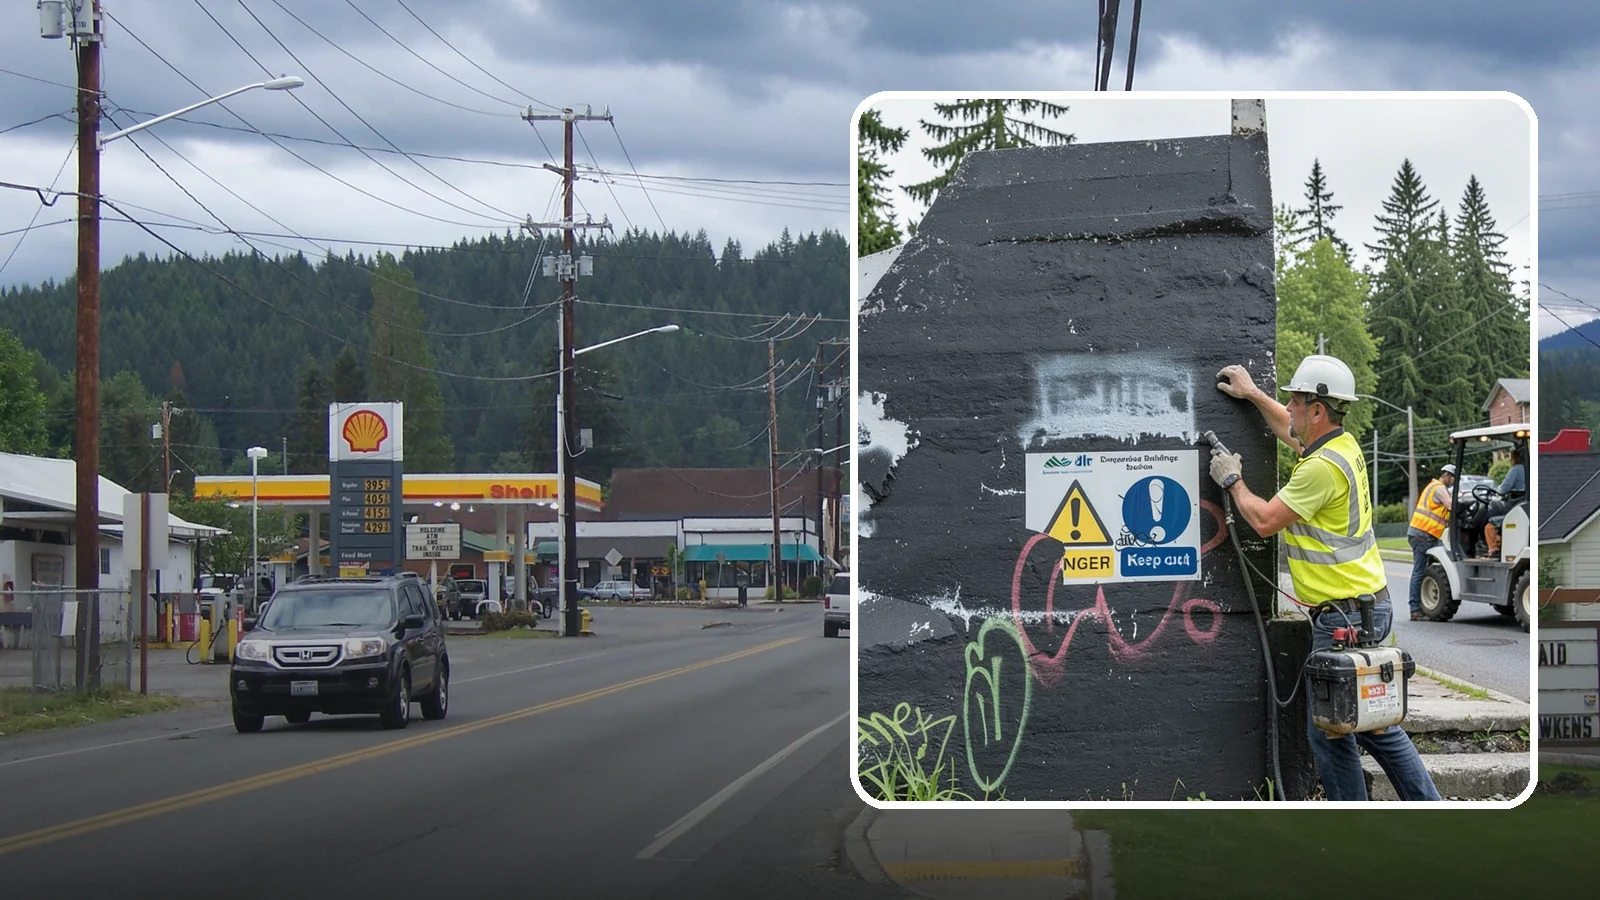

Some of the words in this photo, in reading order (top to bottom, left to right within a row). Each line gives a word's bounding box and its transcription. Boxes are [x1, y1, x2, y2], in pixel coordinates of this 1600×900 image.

[490, 484, 547, 499] Shell
[1063, 556, 1110, 570] NGER
[1127, 554, 1160, 569] Keep
